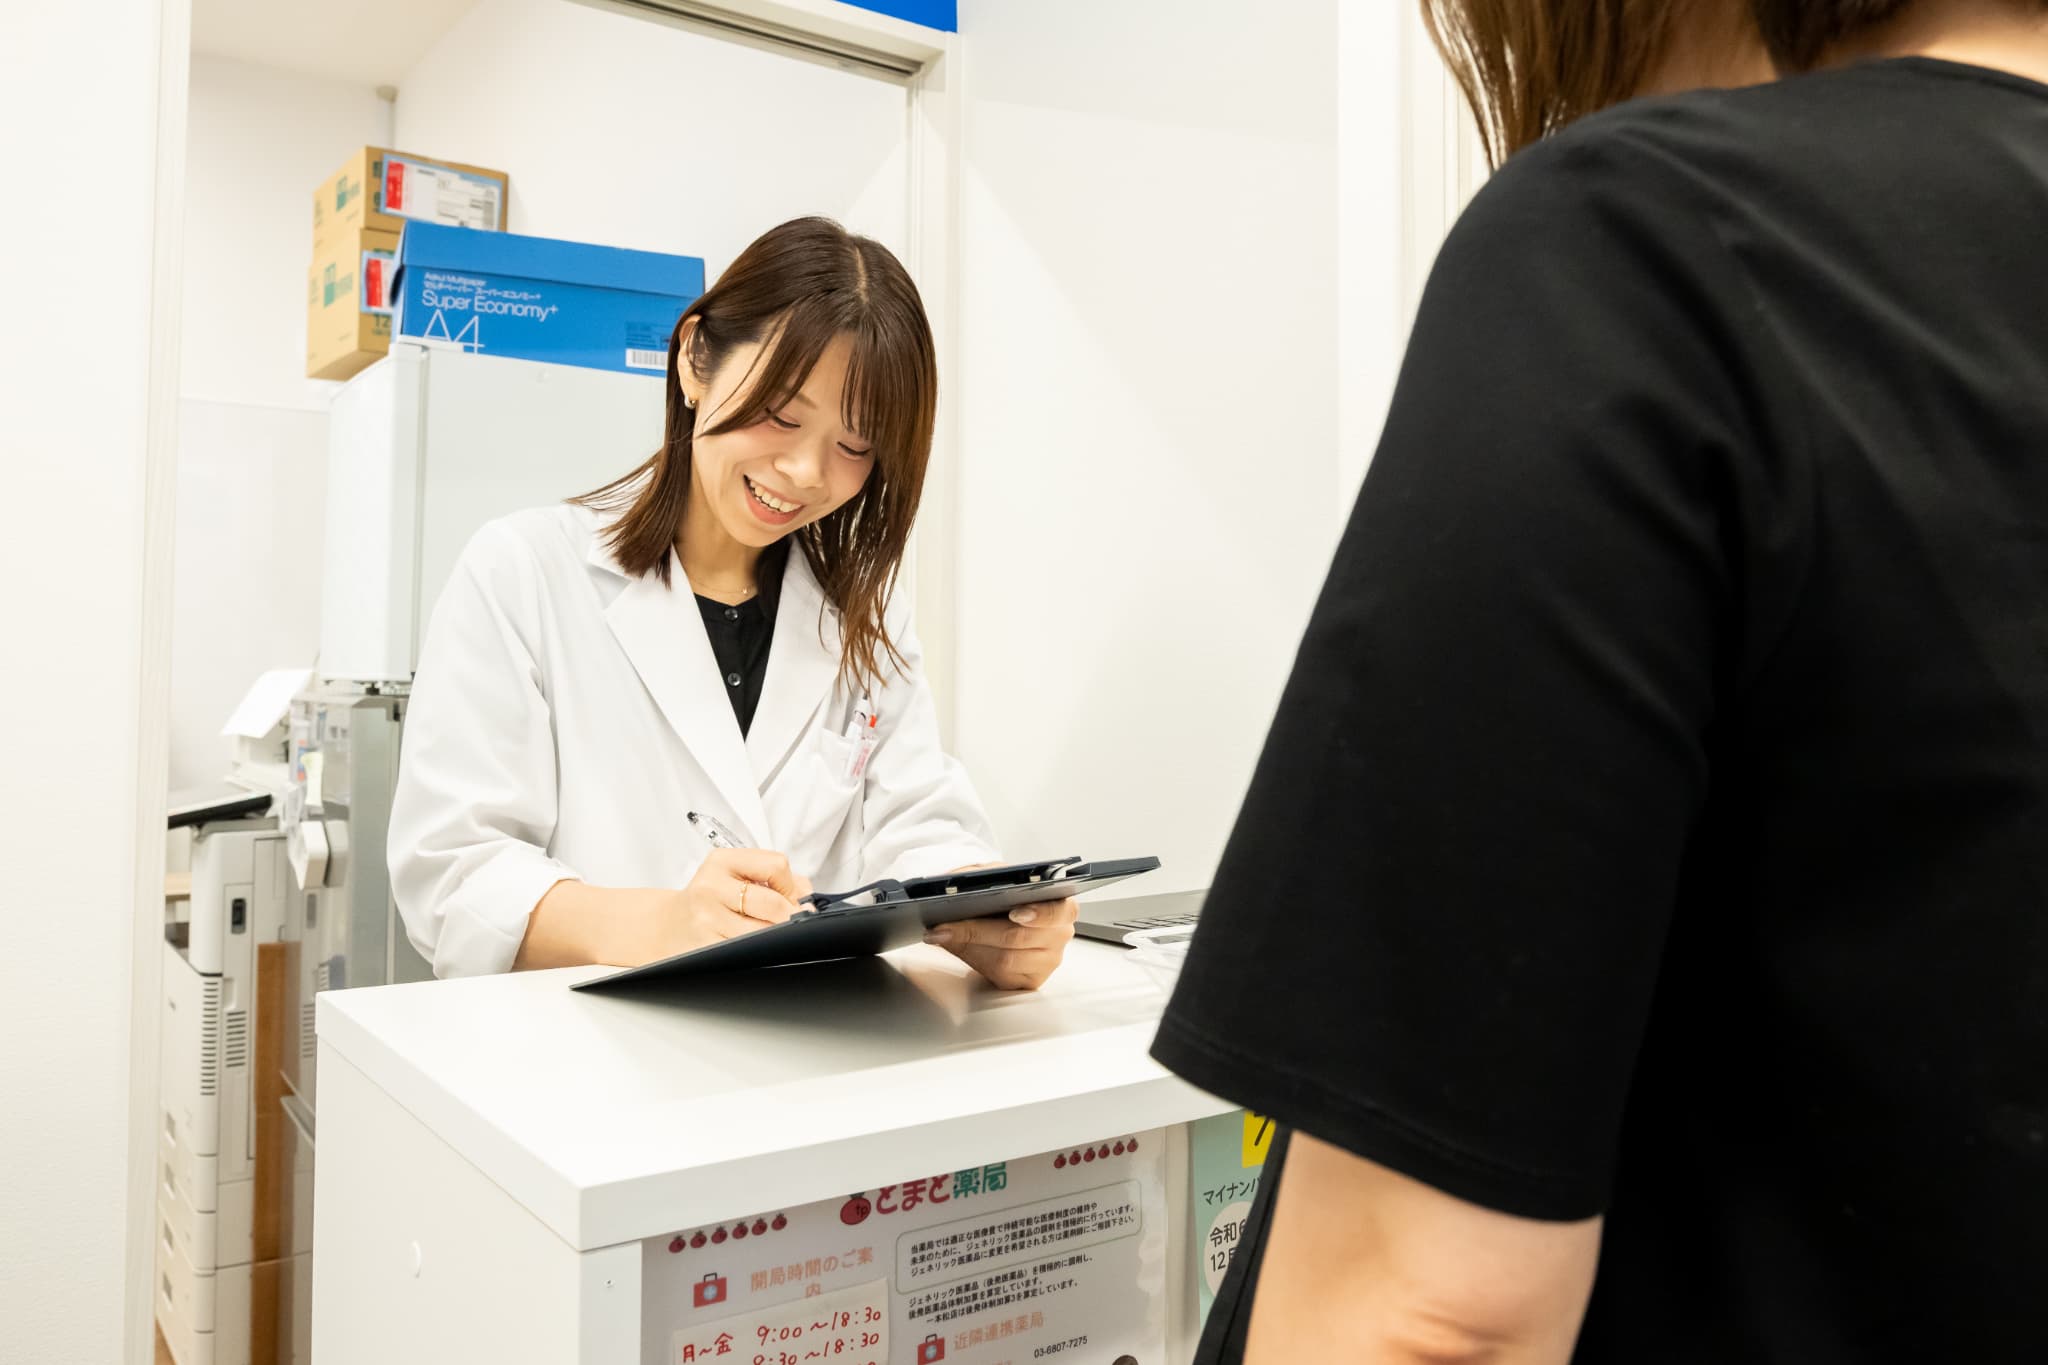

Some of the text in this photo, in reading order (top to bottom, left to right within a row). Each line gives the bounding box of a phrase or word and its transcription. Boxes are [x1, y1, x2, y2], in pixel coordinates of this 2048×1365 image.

[422, 289, 472, 311] Super
[423, 308, 486, 354] A4
[876, 1161, 1007, 1215] とまと薬局
[751, 1246, 873, 1294] 開局時間のご案
[954, 1311, 1044, 1350] 近隣連携薬局
[1033, 1335, 1089, 1359] 03-6807-7275
